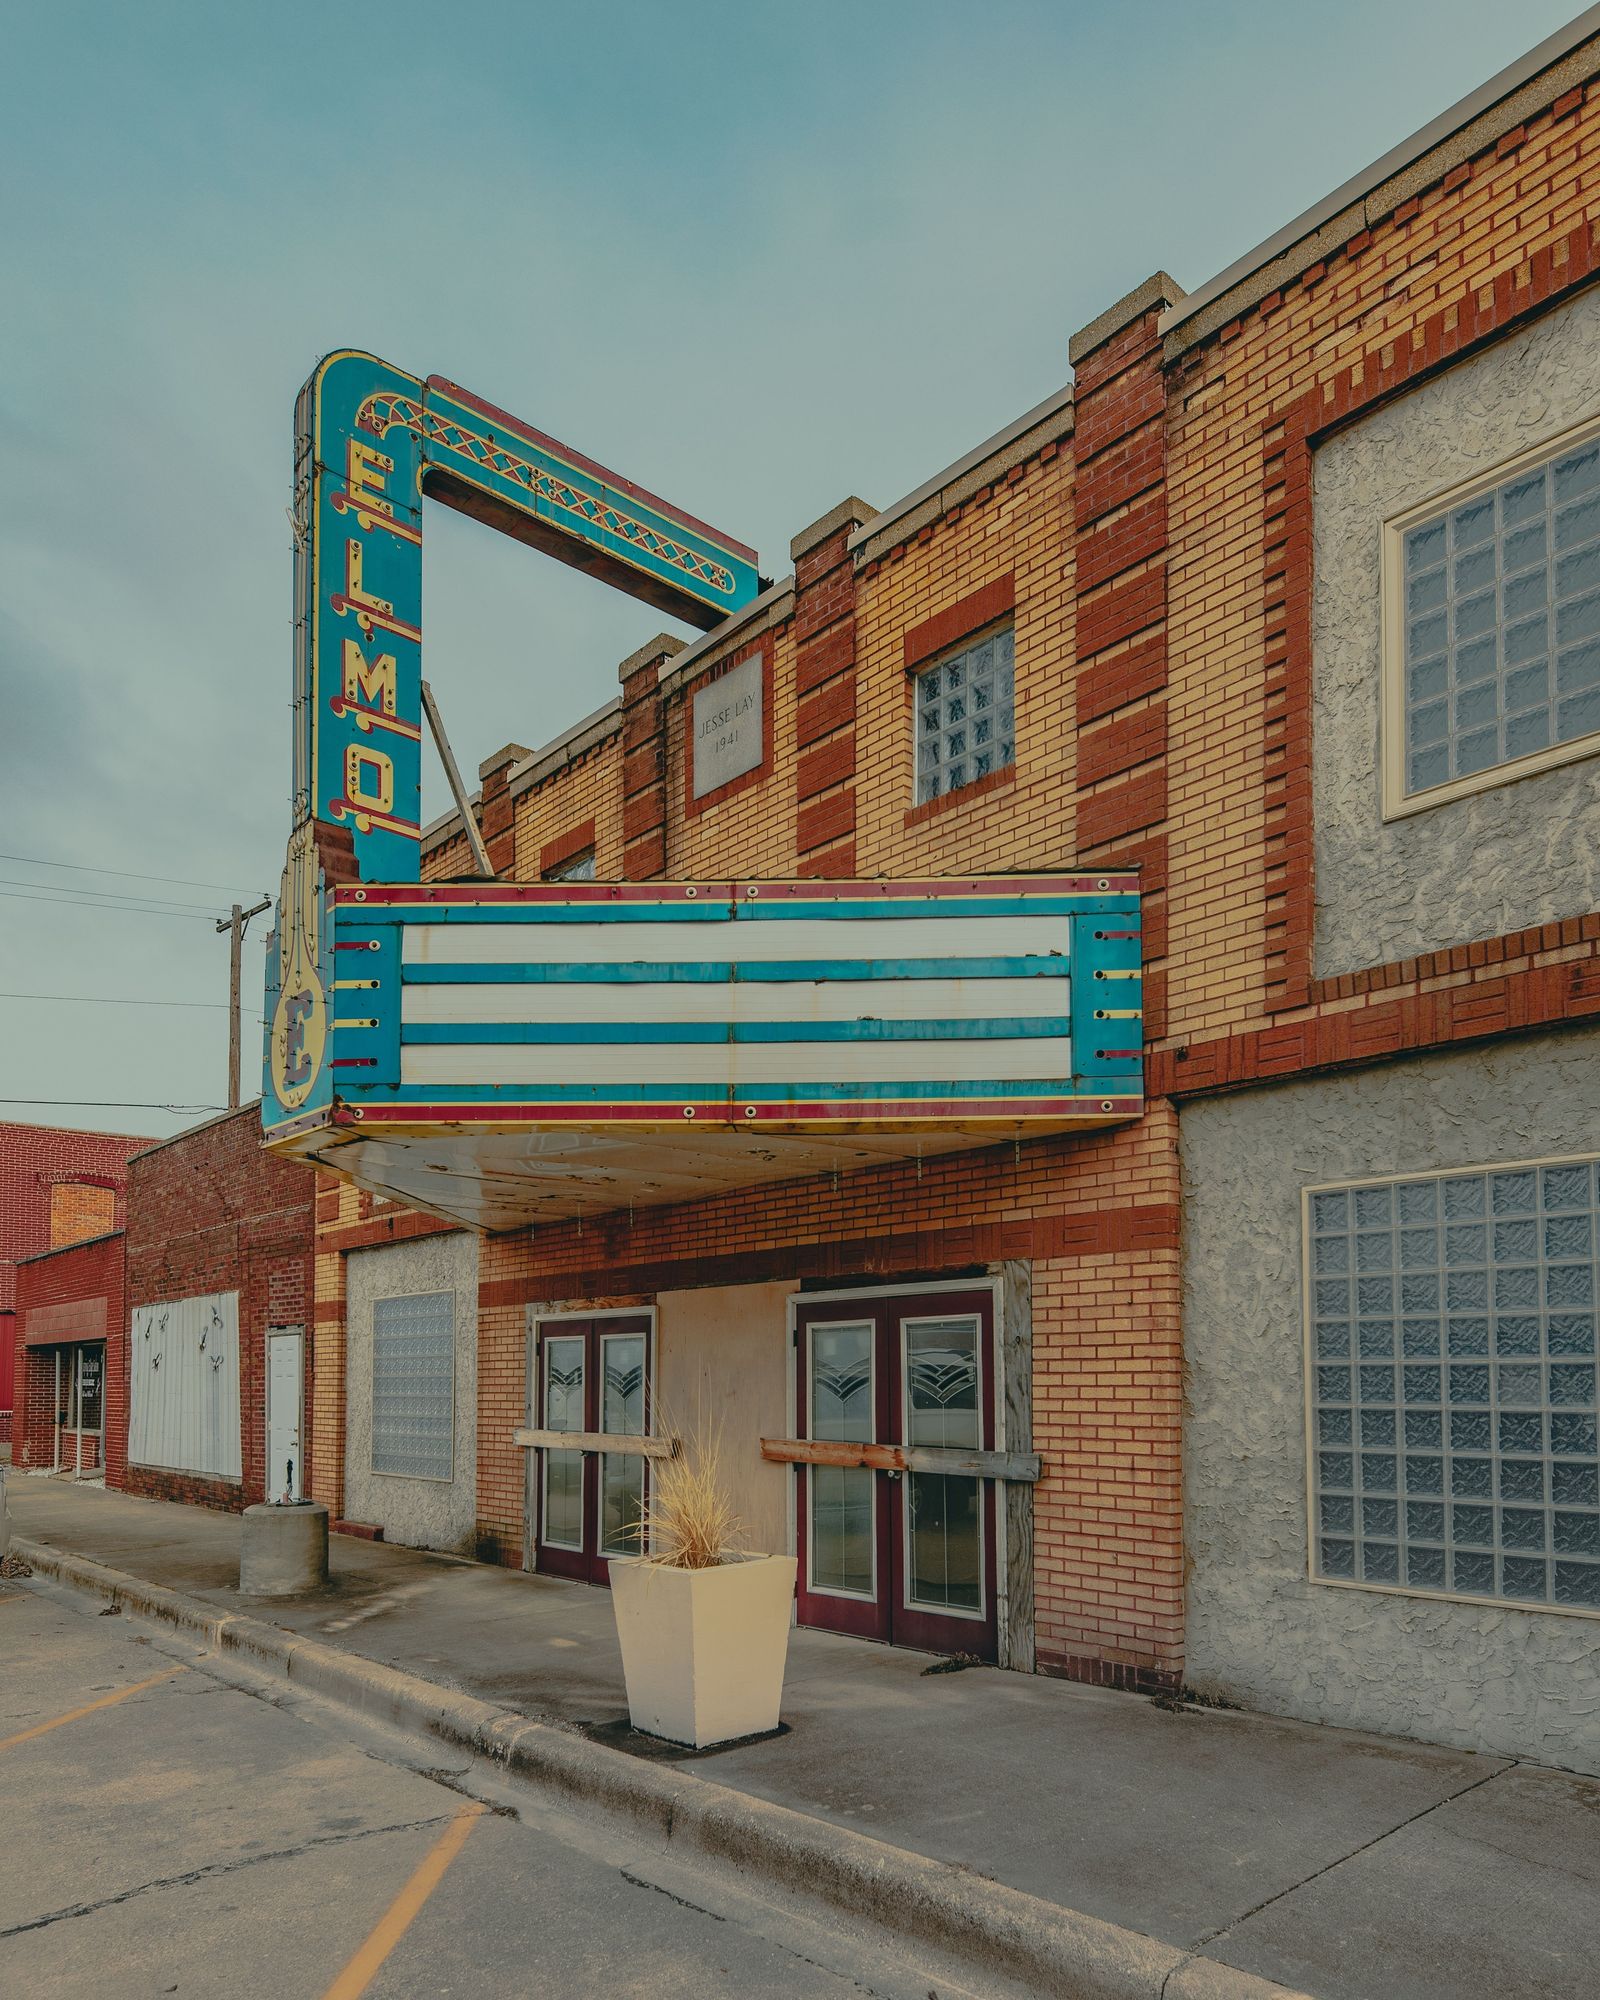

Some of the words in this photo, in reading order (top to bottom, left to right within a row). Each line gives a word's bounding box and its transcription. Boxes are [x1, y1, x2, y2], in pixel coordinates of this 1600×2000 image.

[343, 438, 397, 814] ELMO
[699, 707, 731, 739] JESSE
[735, 691, 756, 717] LAY
[715, 730, 739, 753] 1941
[283, 988, 314, 1092] E
